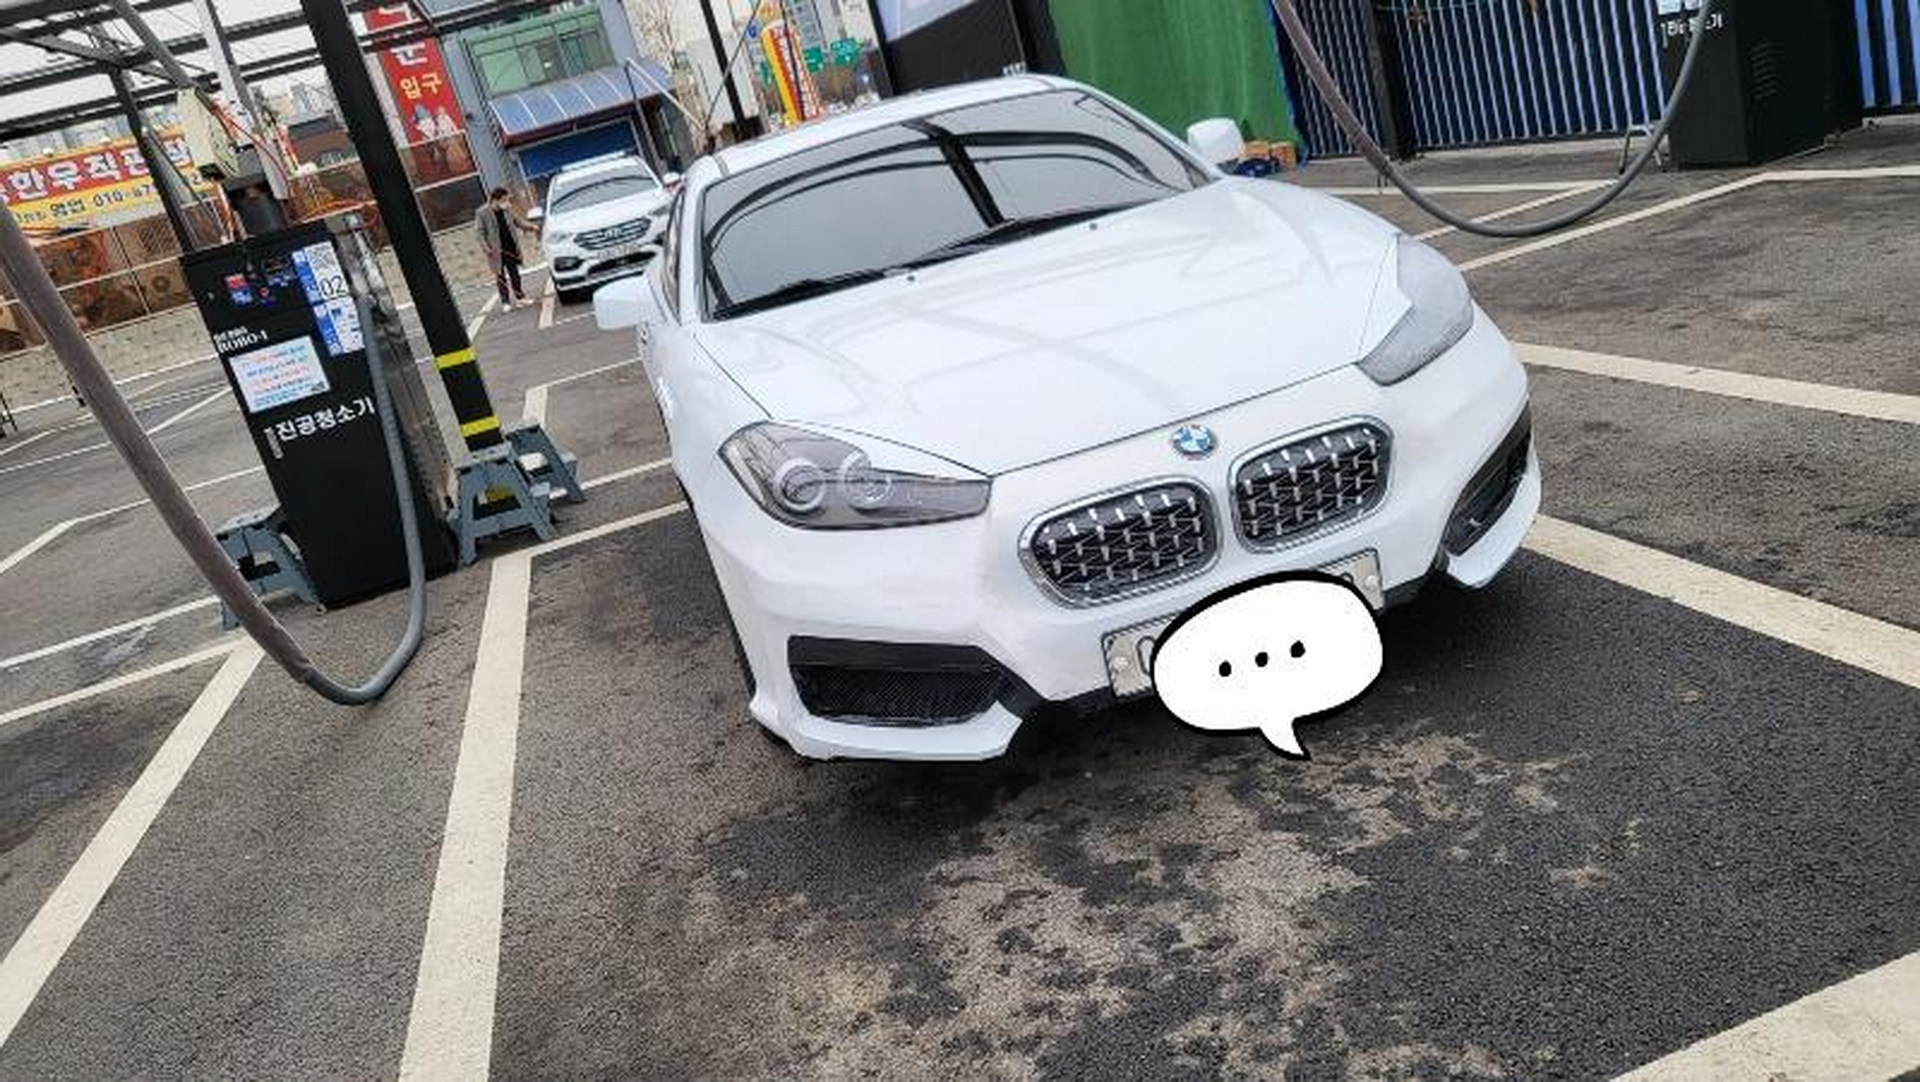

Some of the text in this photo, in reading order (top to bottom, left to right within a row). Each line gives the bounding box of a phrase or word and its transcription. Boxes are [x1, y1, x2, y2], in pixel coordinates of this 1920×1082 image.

[400, 71, 442, 100] 입구
[319, 275, 348, 299] 02
[275, 396, 375, 442] 진공청소기
